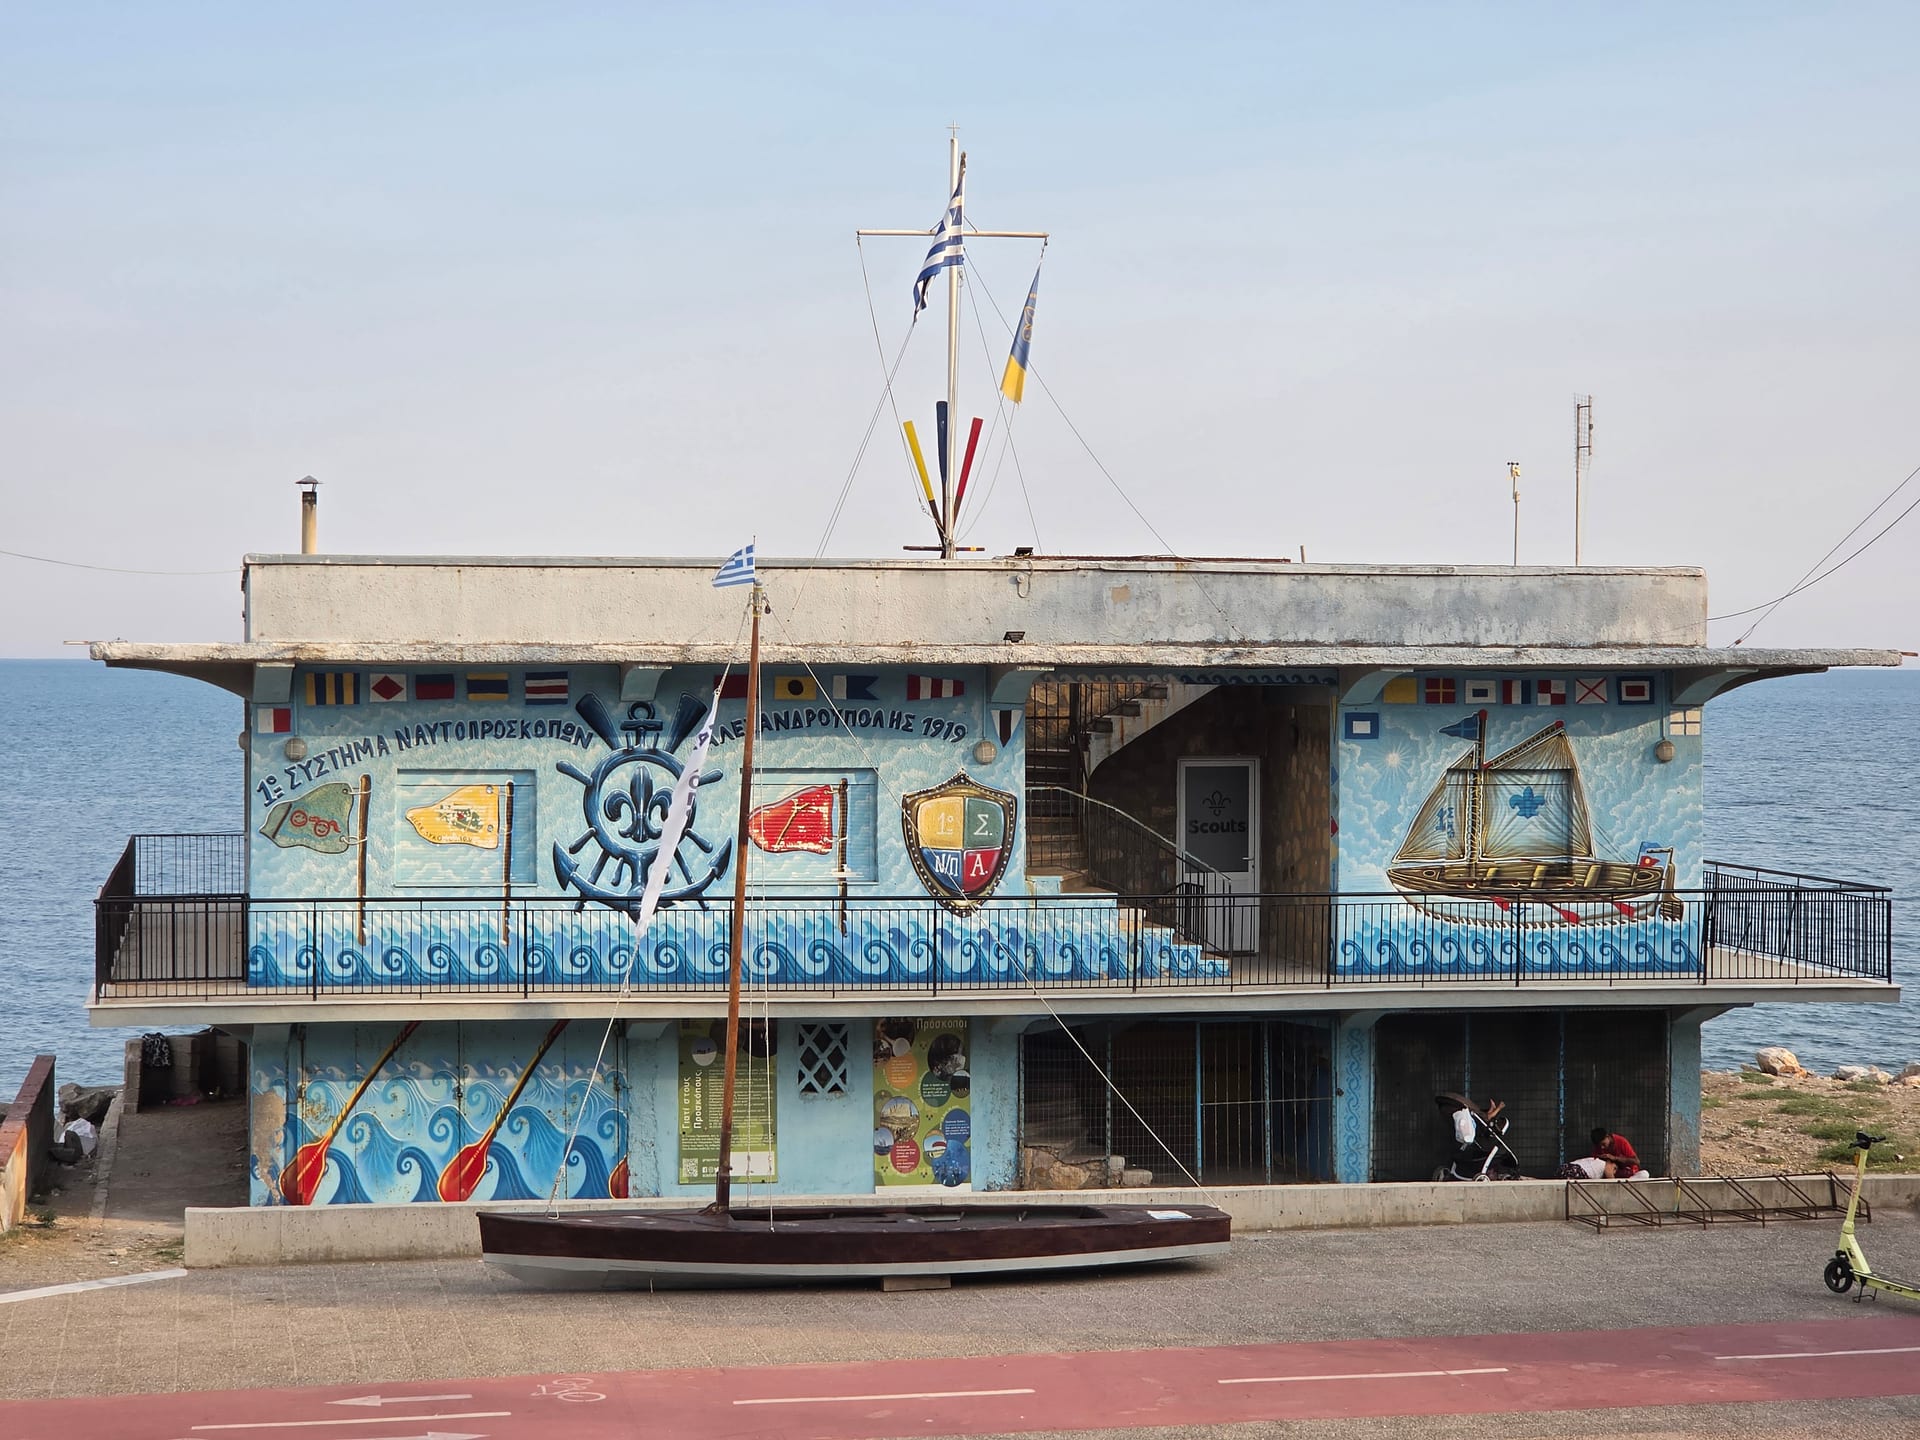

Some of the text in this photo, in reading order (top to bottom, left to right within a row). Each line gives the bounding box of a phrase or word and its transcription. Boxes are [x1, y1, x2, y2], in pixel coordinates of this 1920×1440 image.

[284, 734, 391, 791] ΣΥΣΤΗΜΑ
[921, 716, 969, 744] 1919
[1188, 819, 1247, 834] Scouts
